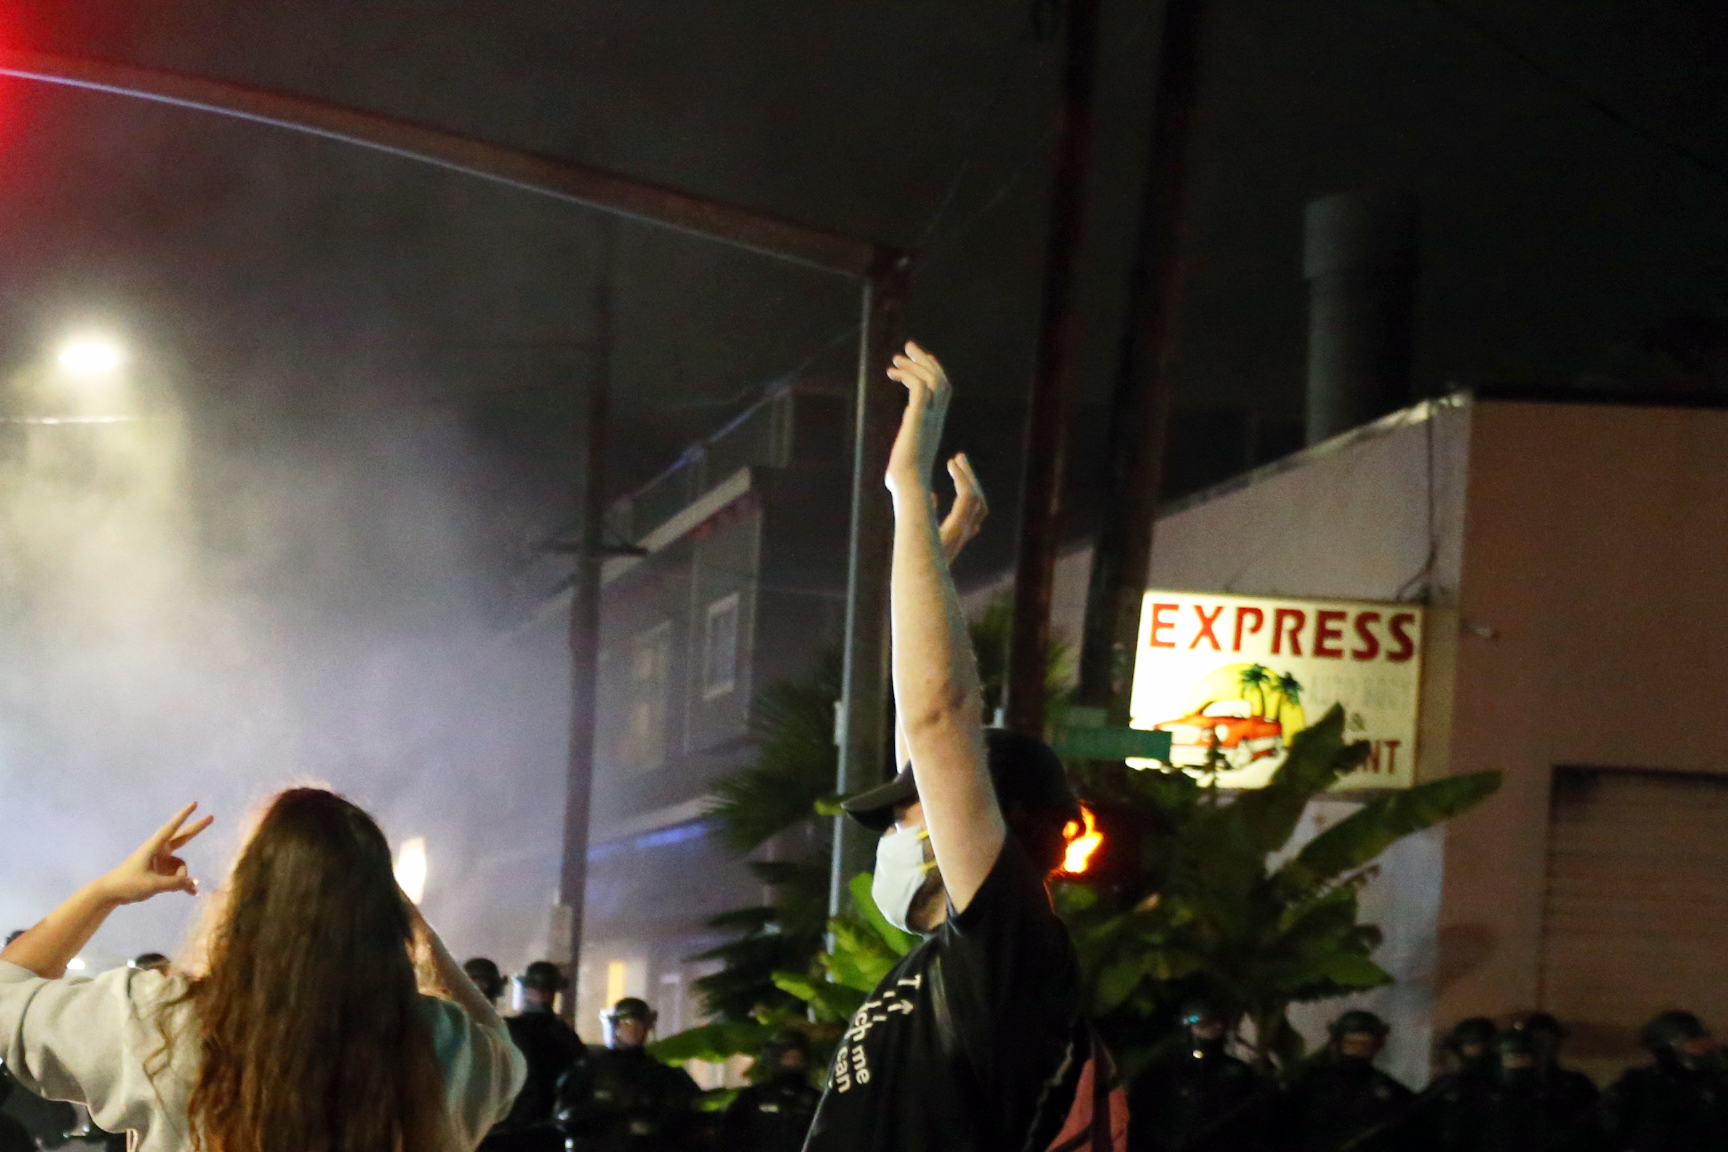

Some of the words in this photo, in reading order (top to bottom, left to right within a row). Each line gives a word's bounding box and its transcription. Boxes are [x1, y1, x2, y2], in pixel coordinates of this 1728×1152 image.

[1149, 602, 1416, 663] EXPRESS
[835, 1046, 851, 1094] can
[851, 1044, 871, 1084] me
